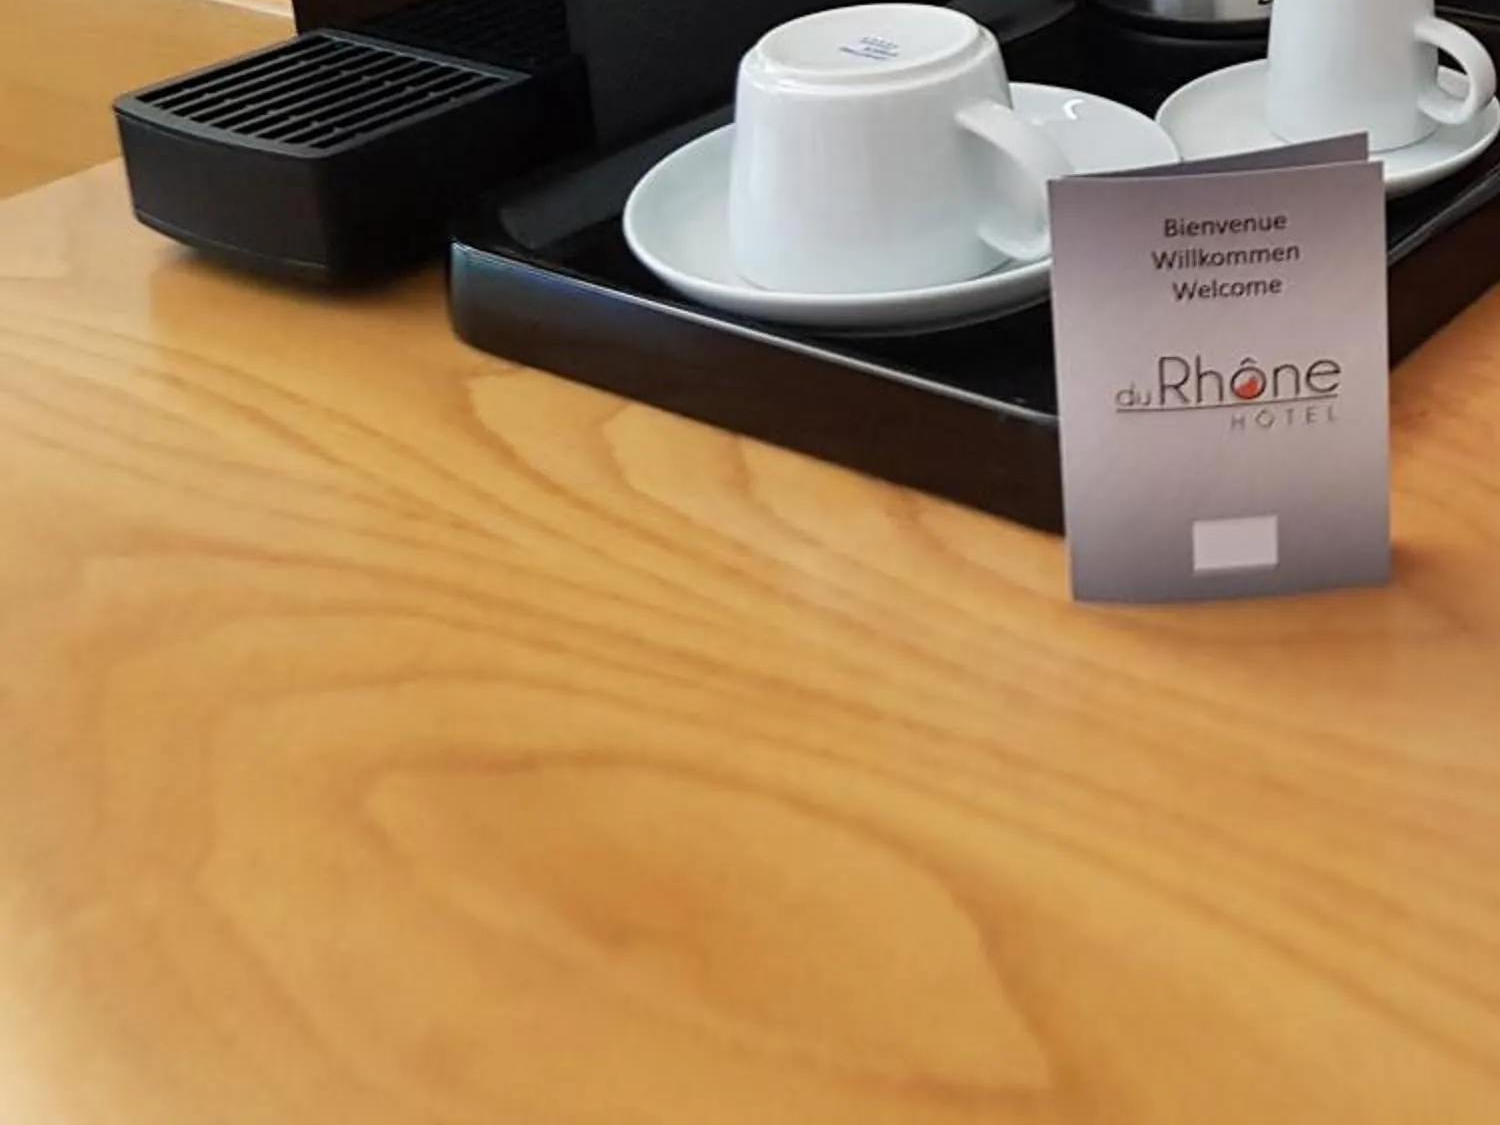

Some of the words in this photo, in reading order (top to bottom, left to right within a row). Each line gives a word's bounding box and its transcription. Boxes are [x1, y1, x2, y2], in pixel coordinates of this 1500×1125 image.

[1164, 214, 1288, 239] Bienvenue
[1151, 244, 1300, 271] Willkommen
[1172, 277, 1284, 302] Welcome
[1115, 381, 1152, 407] du
[1157, 354, 1342, 406] Rhône
